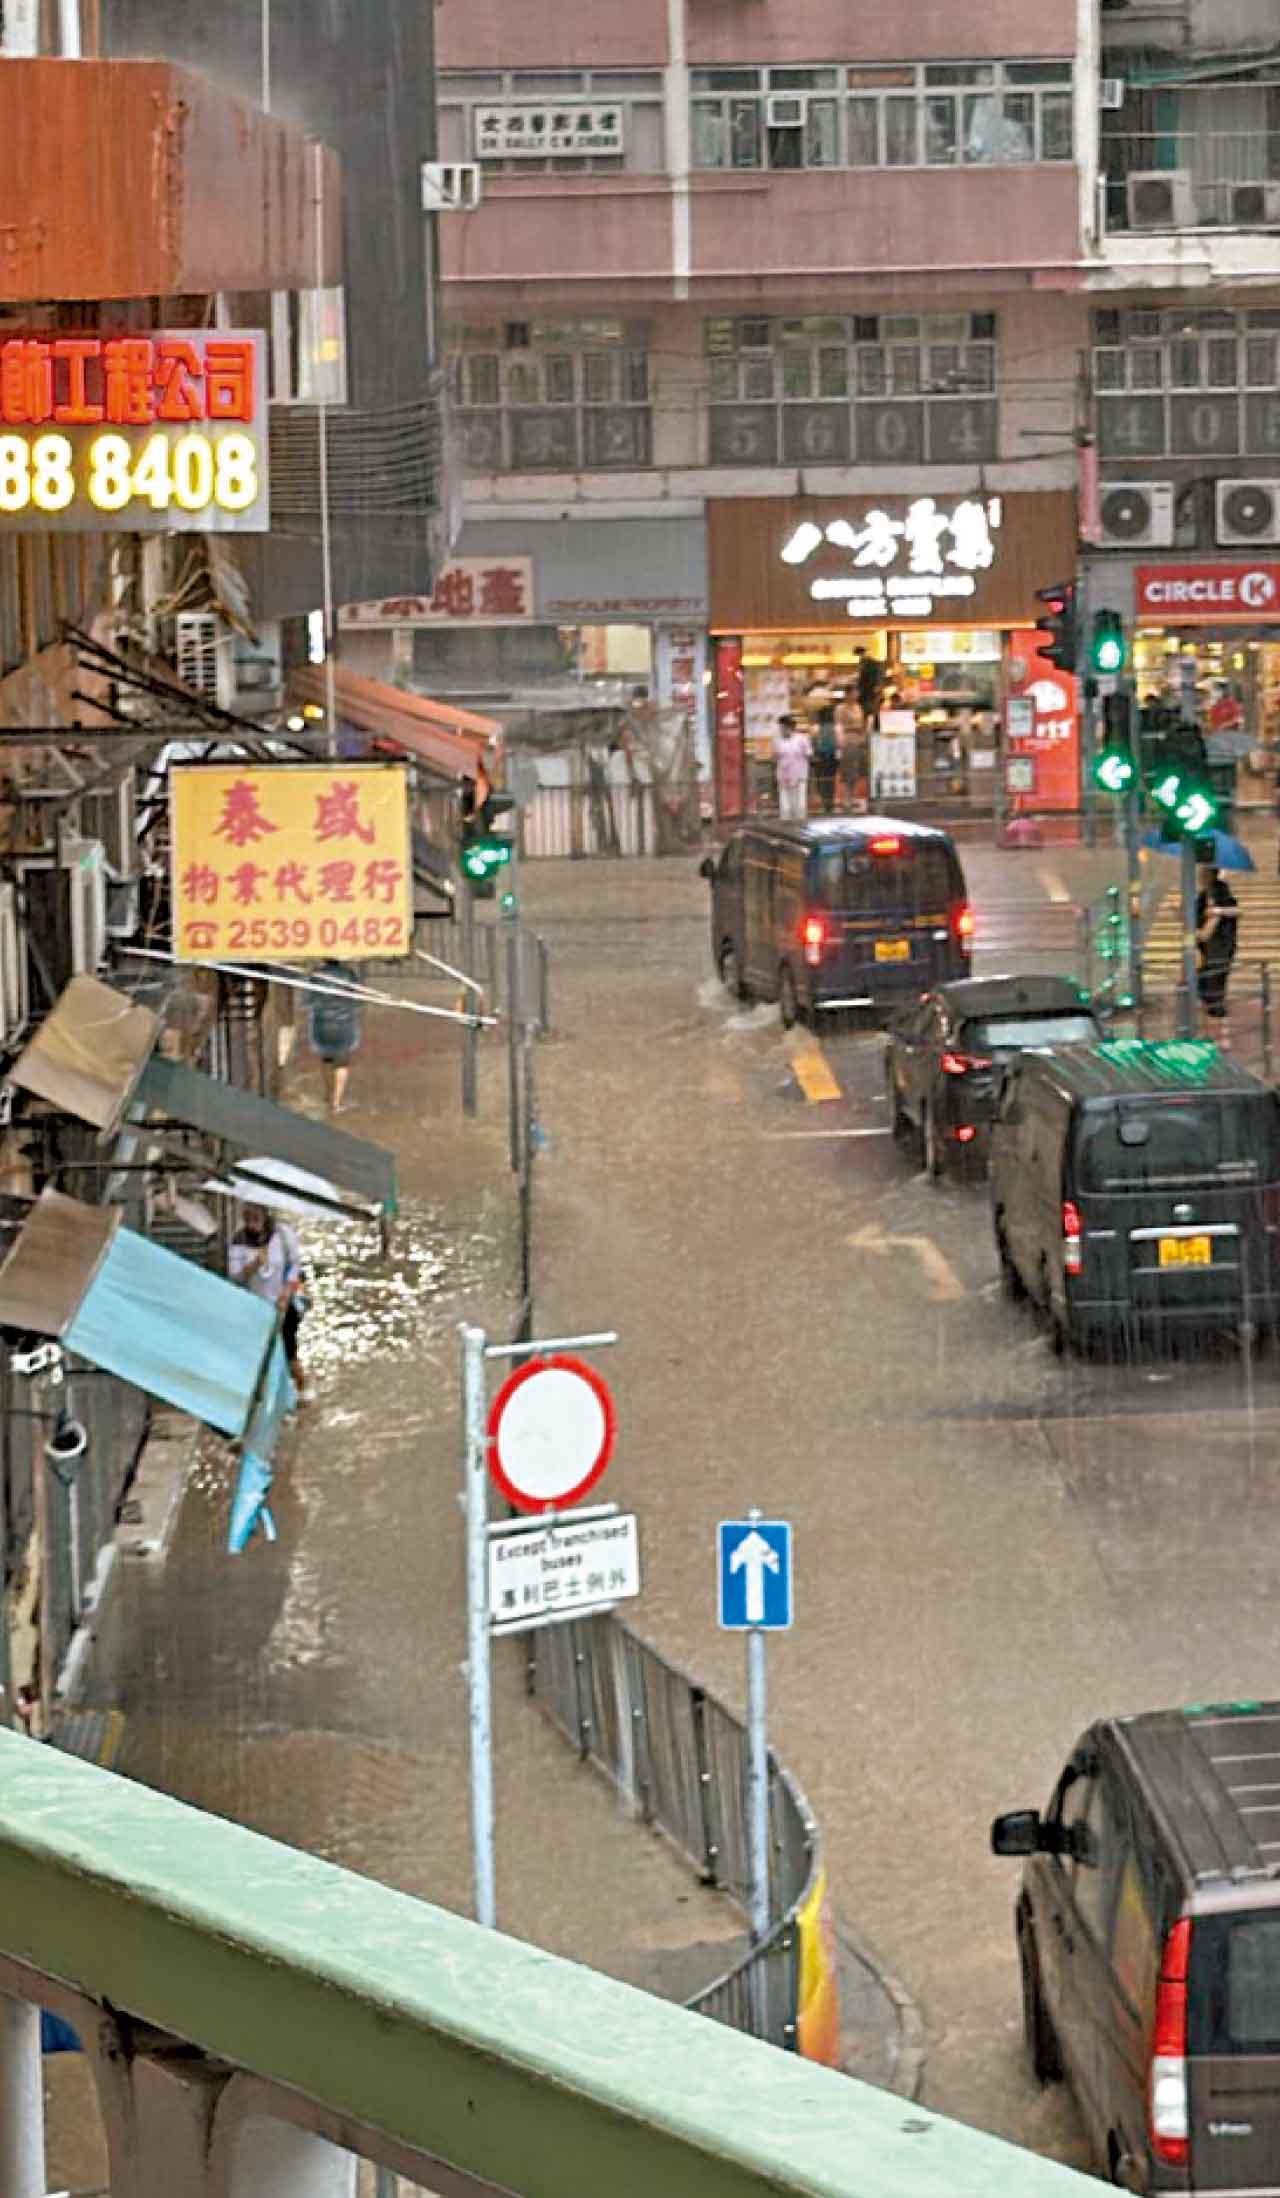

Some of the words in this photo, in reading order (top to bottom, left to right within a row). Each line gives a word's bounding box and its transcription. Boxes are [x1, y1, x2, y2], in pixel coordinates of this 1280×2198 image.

[1, 338, 256, 424] 飾工程公司
[89, 433, 257, 511] 8408
[1145, 580, 1234, 602] CIRCLE
[1241, 571, 1275, 606] K
[181, 859, 403, 906] 物業代理行
[227, 920, 311, 948] 2539
[319, 916, 403, 947] 0482
[497, 1539, 546, 1561] Except
[549, 1523, 628, 1549] franchised
[540, 1554, 582, 1571] buses
